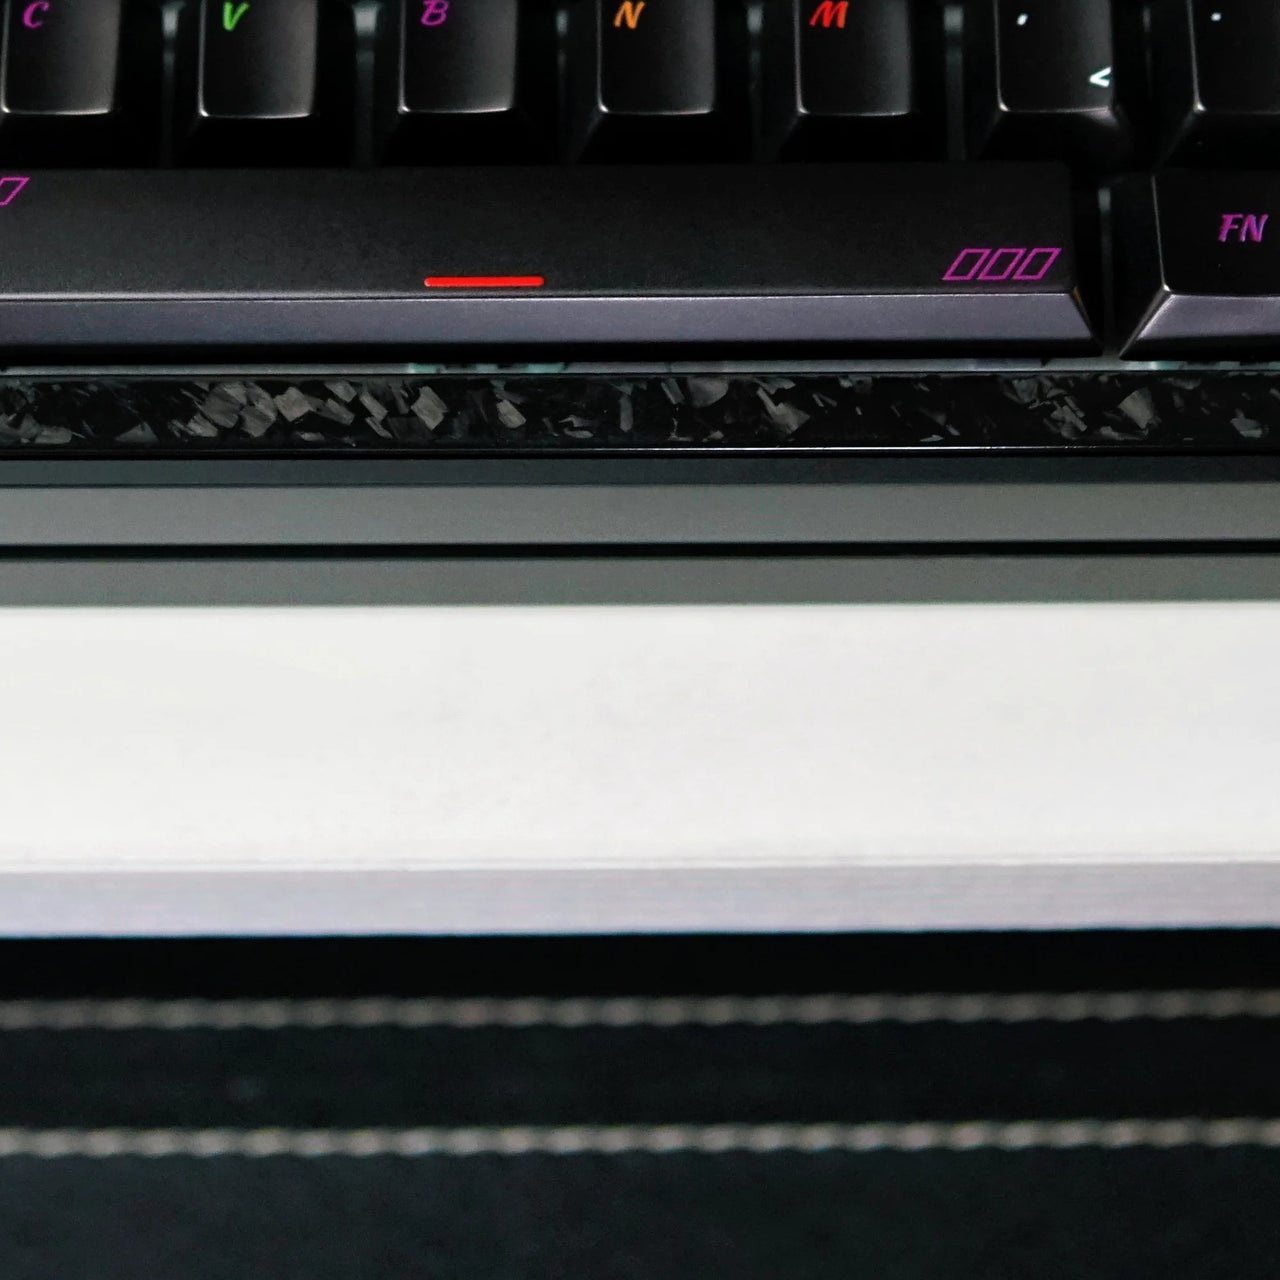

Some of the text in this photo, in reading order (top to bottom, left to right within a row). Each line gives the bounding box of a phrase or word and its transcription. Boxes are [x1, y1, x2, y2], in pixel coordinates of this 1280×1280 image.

[22, 0, 50, 29] C
[223, 1, 249, 31] V
[614, 0, 645, 29] N
[809, 0, 849, 28] M
[1219, 213, 1268, 243] FN
